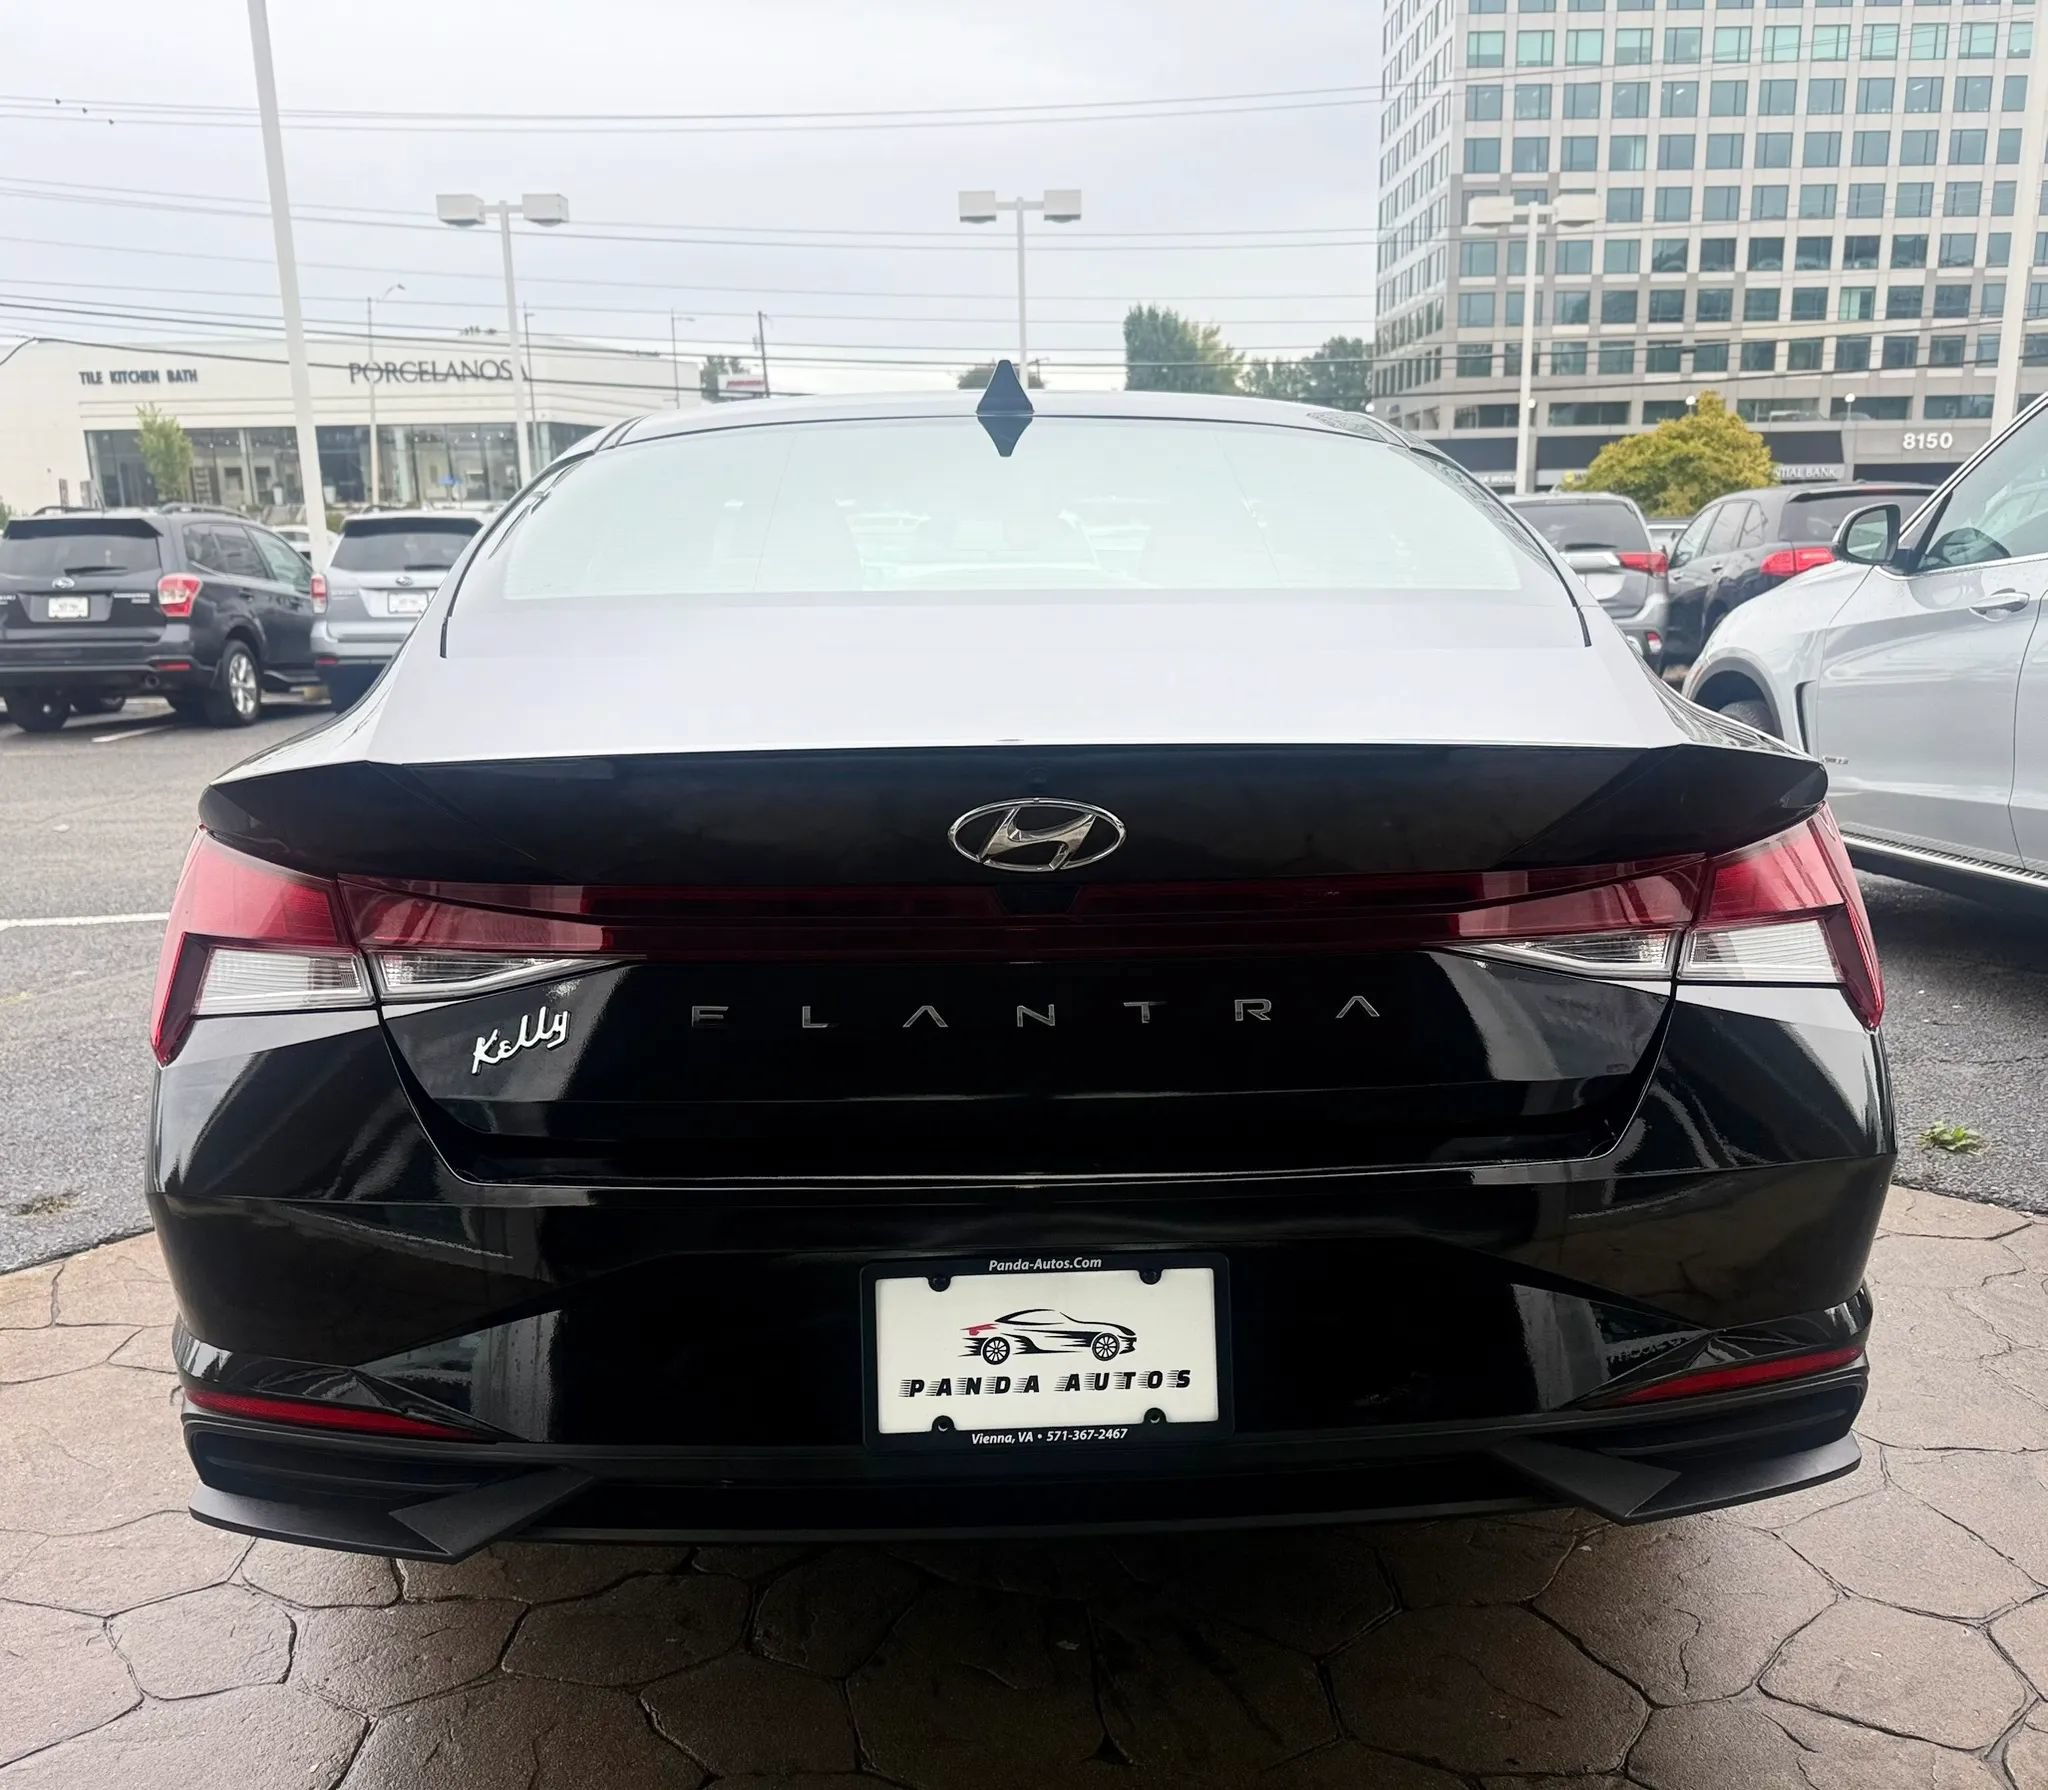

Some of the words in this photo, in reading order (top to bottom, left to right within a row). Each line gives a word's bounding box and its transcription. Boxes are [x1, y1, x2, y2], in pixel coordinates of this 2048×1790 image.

[78, 371, 103, 385] TILE
[109, 369, 160, 384] KITCHEN
[166, 369, 198, 383] BATH
[1902, 431, 1953, 450] 8150
[1806, 466, 1837, 478] BANK
[691, 995, 1381, 1029] ELANTRA
[472, 1005, 569, 1075] Kelly
[988, 1256, 1102, 1272] Panda-Autos.Com
[898, 1374, 1040, 1398] PANDA
[1053, 1369, 1192, 1393] AUTOS
[971, 1433, 1016, 1445] Vienna,
[1018, 1431, 1034, 1443] VA
[1046, 1428, 1129, 1442] 571-367-2467
